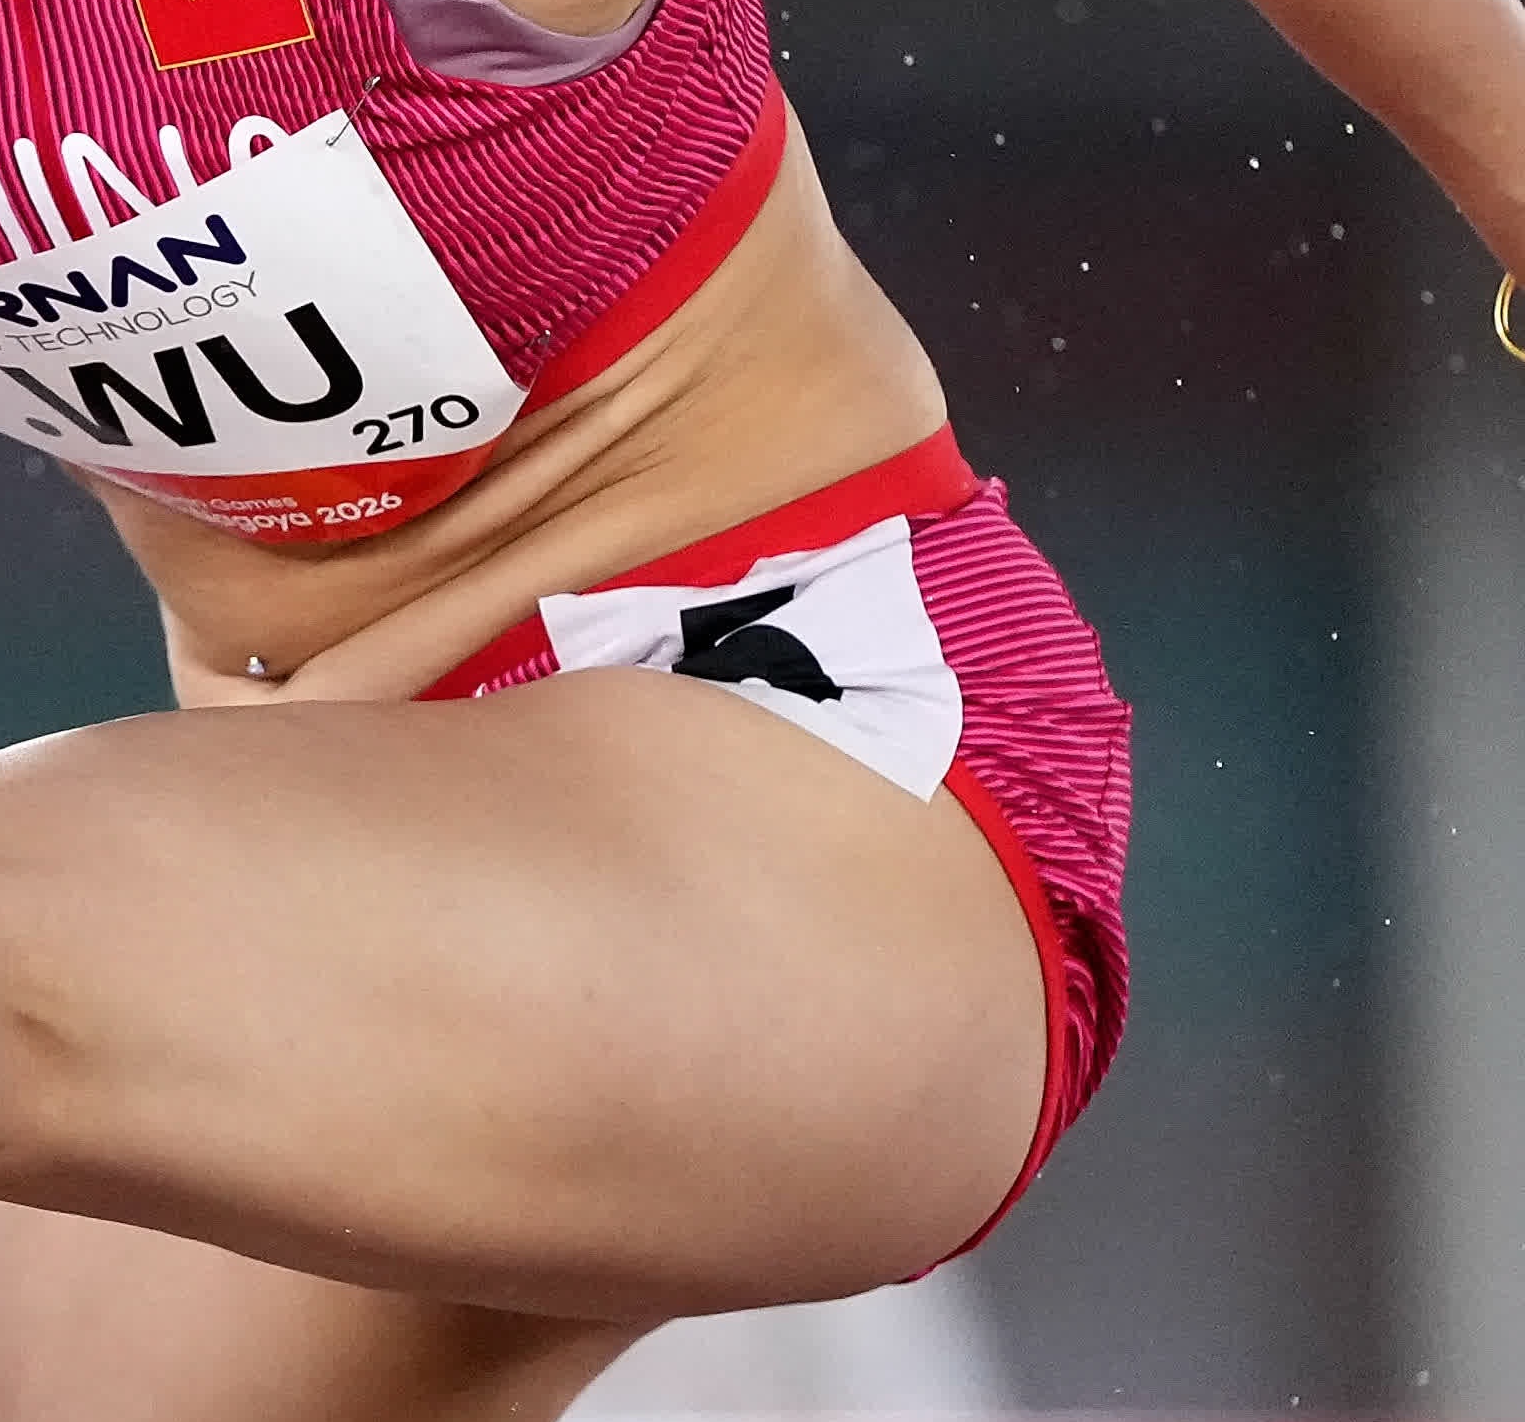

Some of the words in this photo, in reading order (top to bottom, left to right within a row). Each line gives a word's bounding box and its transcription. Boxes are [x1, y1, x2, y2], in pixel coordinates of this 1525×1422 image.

[4, 270, 258, 354] TECHNOLOGY
[352, 393, 480, 457] 270
[316, 491, 404, 526] 2026
